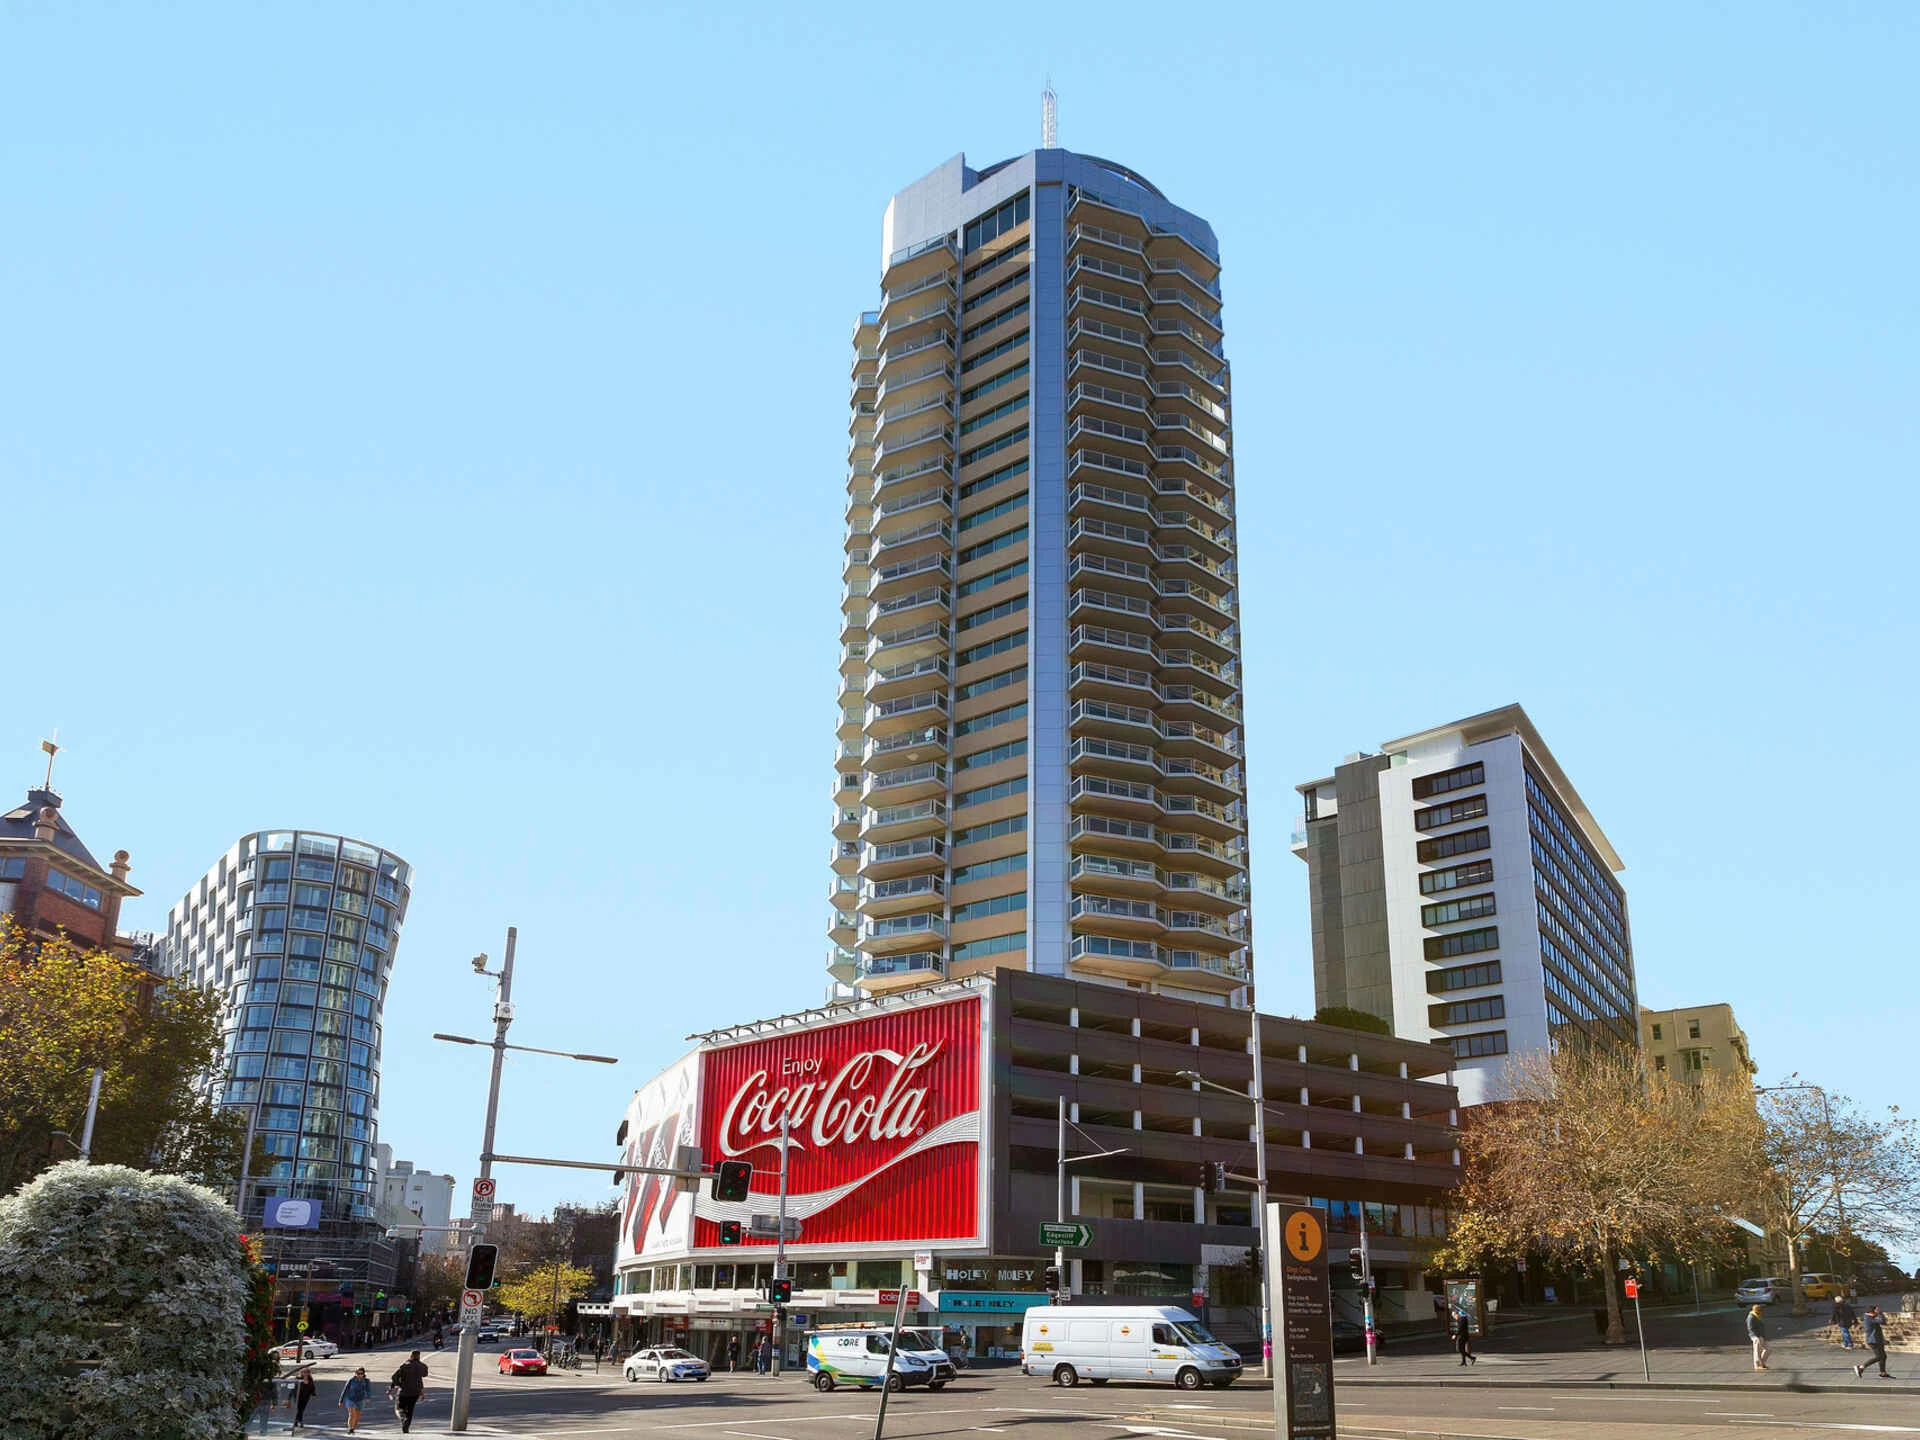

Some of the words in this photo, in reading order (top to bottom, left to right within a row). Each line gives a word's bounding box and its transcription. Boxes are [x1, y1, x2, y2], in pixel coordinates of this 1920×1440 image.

[782, 1056, 823, 1076] Enjoy
[719, 1038, 944, 1157] Coca-Cola
[946, 1269, 990, 1281] HOLEY
[998, 1270, 1034, 1281] MOLEY
[838, 1338, 860, 1347] CORE
